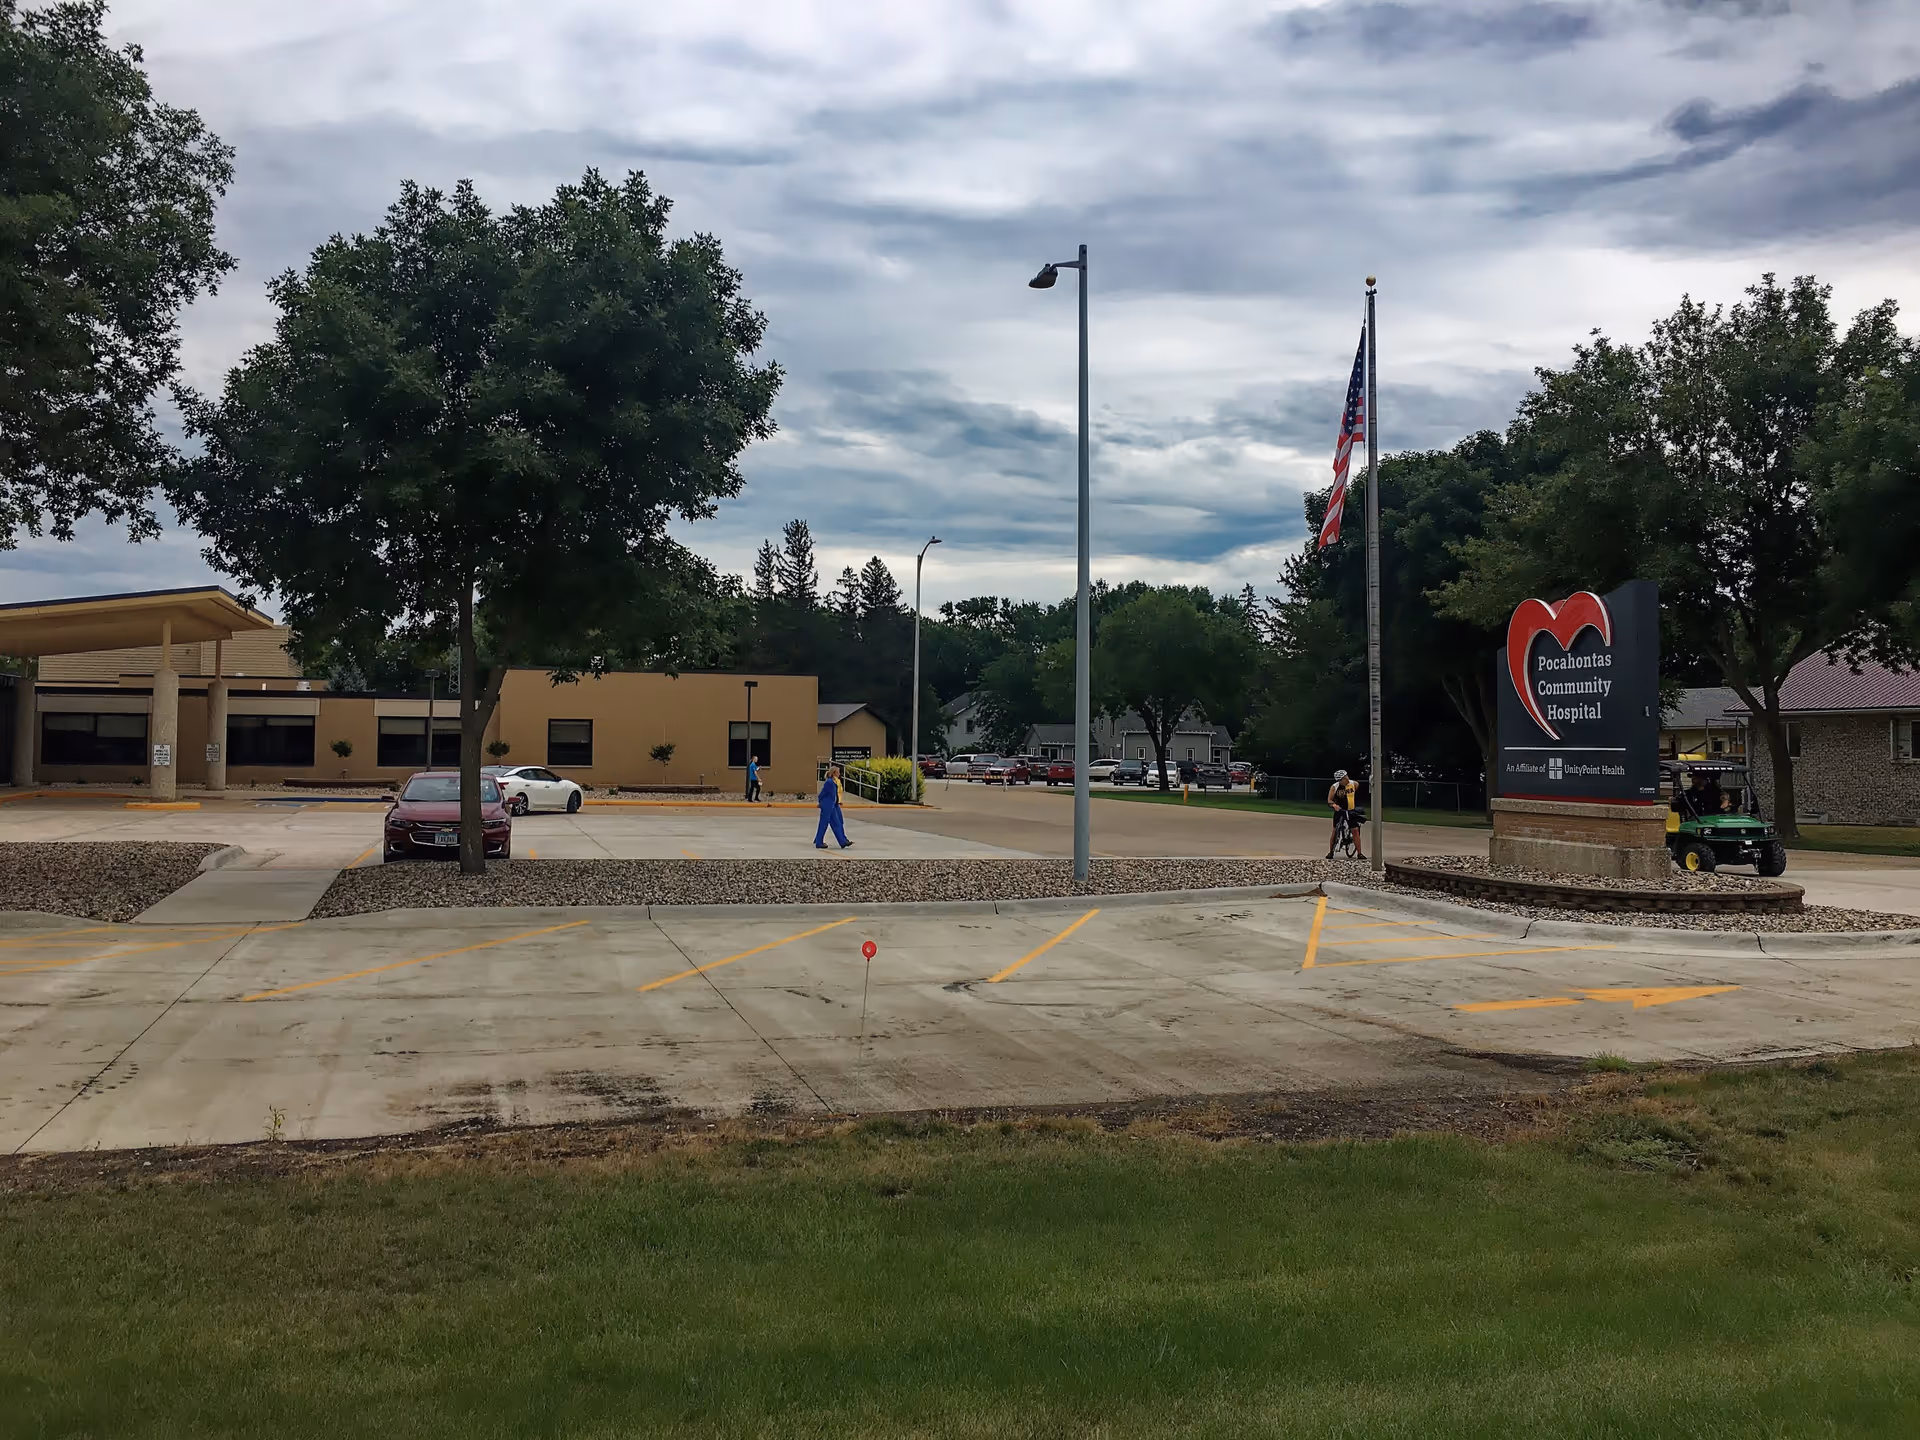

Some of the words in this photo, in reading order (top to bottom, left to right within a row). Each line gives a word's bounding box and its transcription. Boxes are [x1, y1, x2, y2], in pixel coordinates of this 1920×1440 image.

[1538, 653, 1612, 671] Pocahontas
[1537, 676, 1612, 697] Community
[1547, 702, 1602, 723] Hospital
[1506, 764, 1514, 773] An
[1515, 763, 1539, 773] Affiliate
[1539, 763, 1546, 773] of
[1564, 764, 1600, 776] UnityPoint
[1601, 765, 1625, 775] Health
